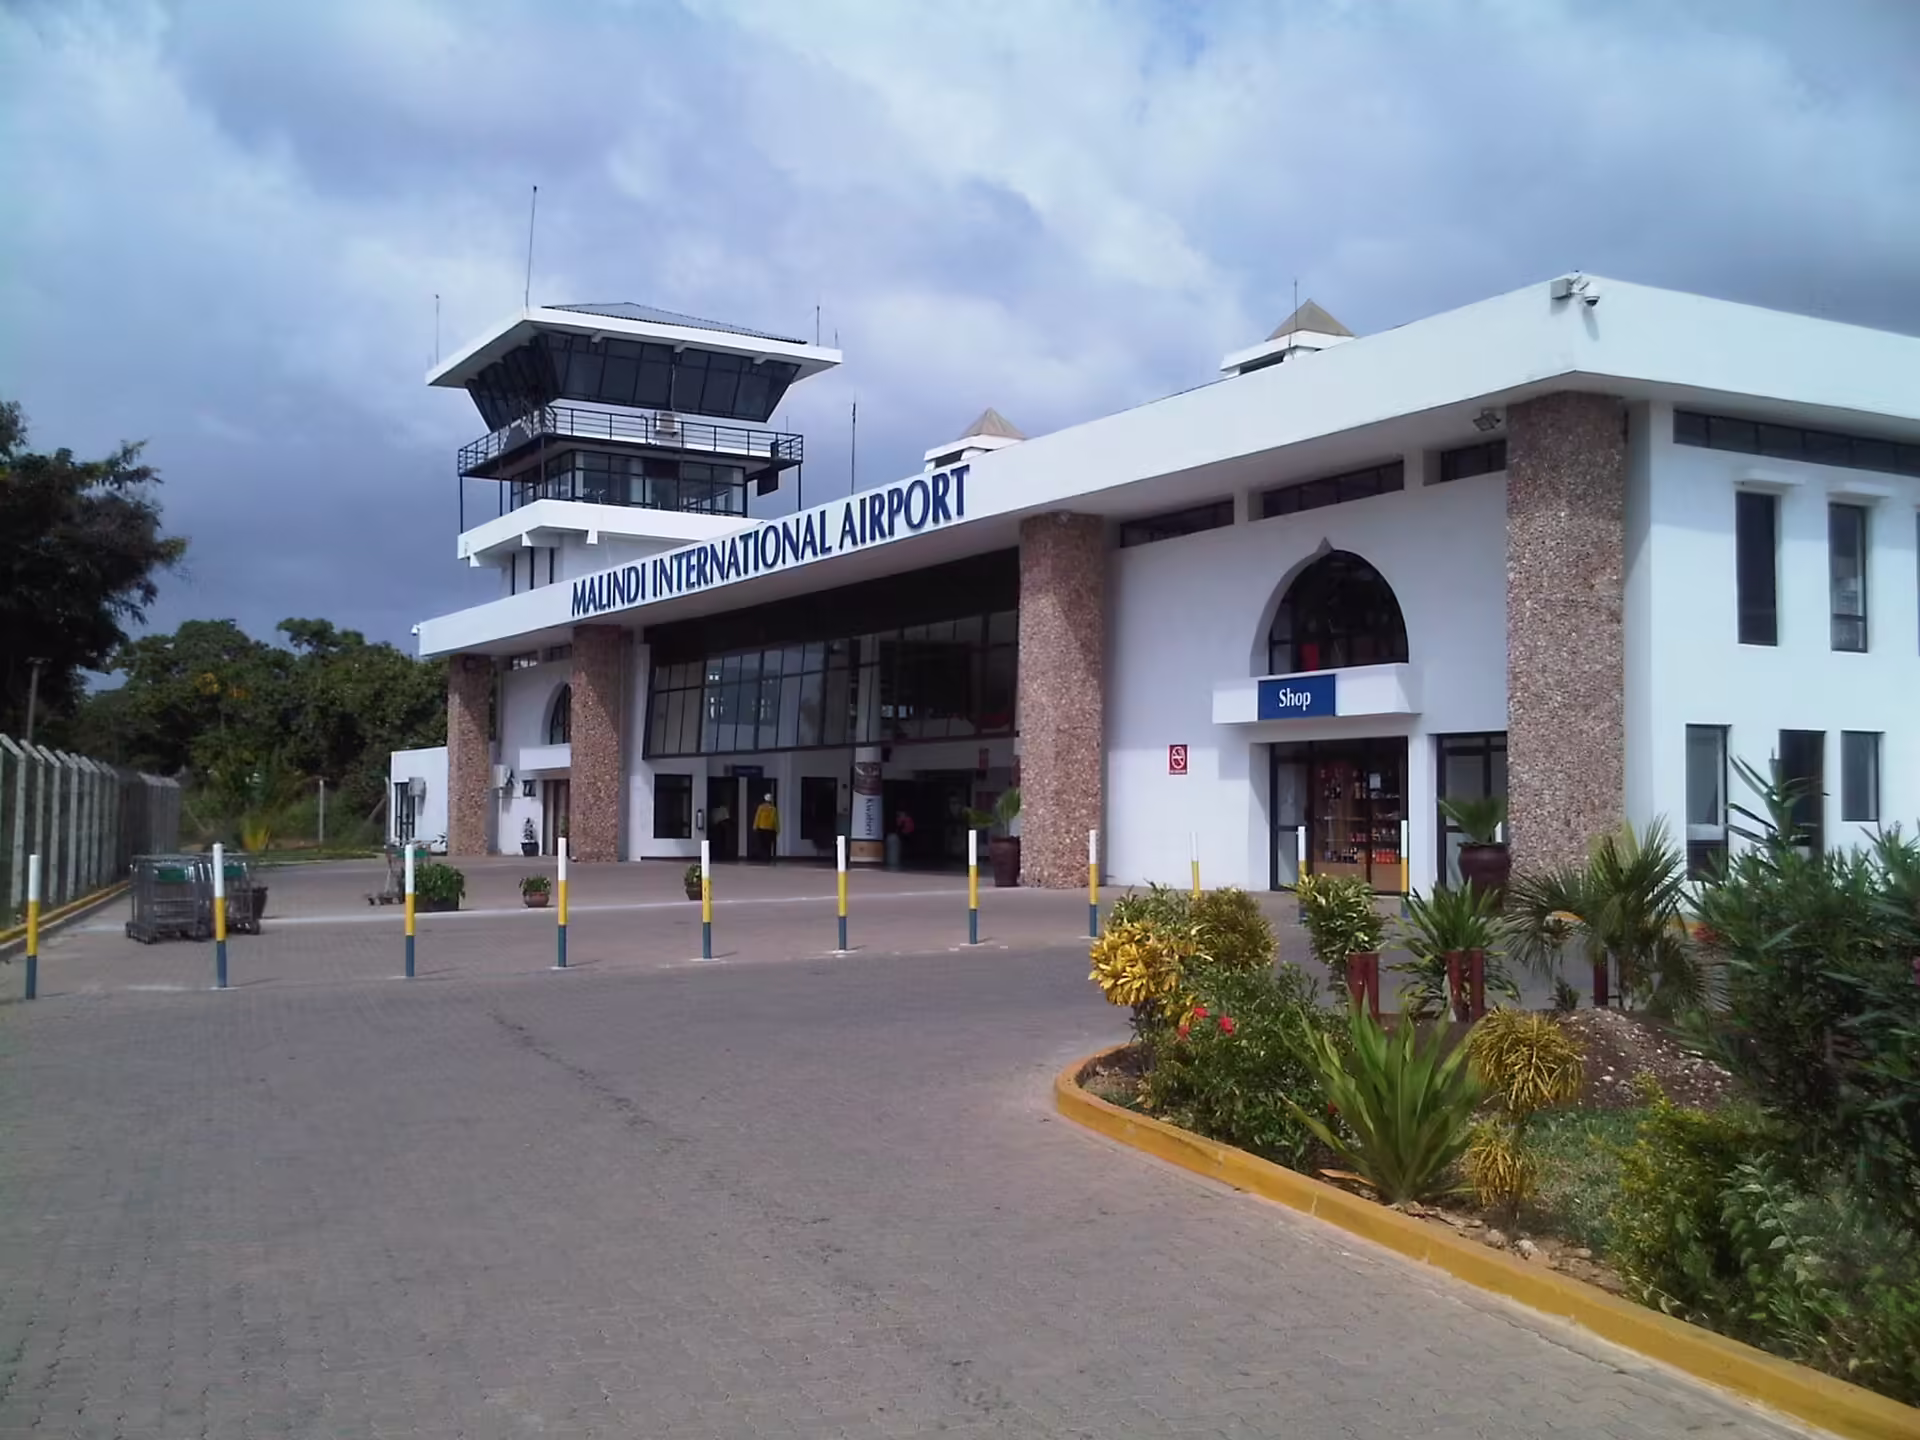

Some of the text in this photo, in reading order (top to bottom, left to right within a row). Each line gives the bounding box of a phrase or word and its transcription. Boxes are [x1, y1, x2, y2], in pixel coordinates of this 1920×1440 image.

[572, 464, 970, 617] MALINDI INTERNATIONAL AIRPORT
[1278, 687, 1311, 711] Shop
